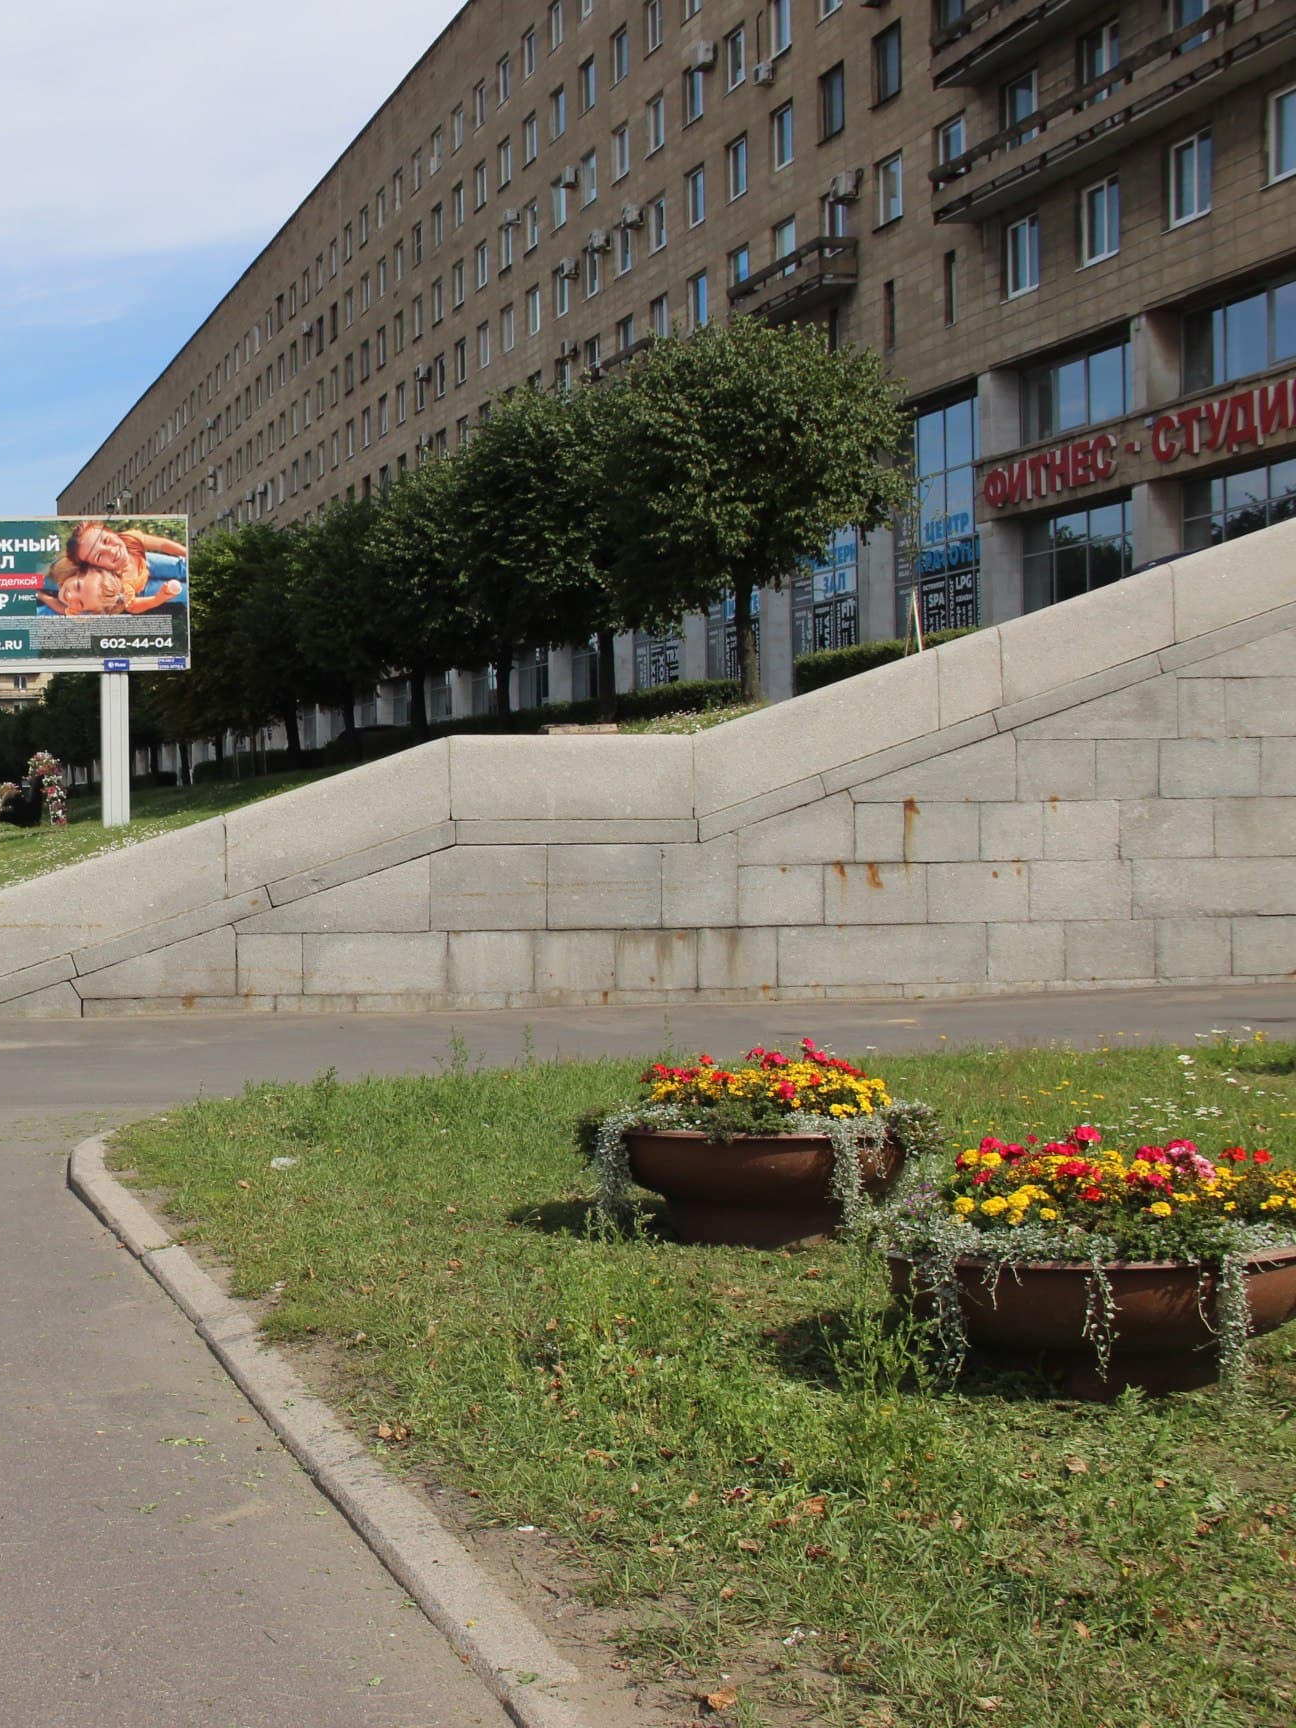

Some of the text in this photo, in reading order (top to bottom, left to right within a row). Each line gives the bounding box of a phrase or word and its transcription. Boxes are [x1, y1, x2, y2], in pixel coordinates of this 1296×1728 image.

[983, 433, 1116, 508] ФИТНЕС
[1152, 378, 1296, 462] СТУДИ
[99, 638, 174, 649] 602-44-04
